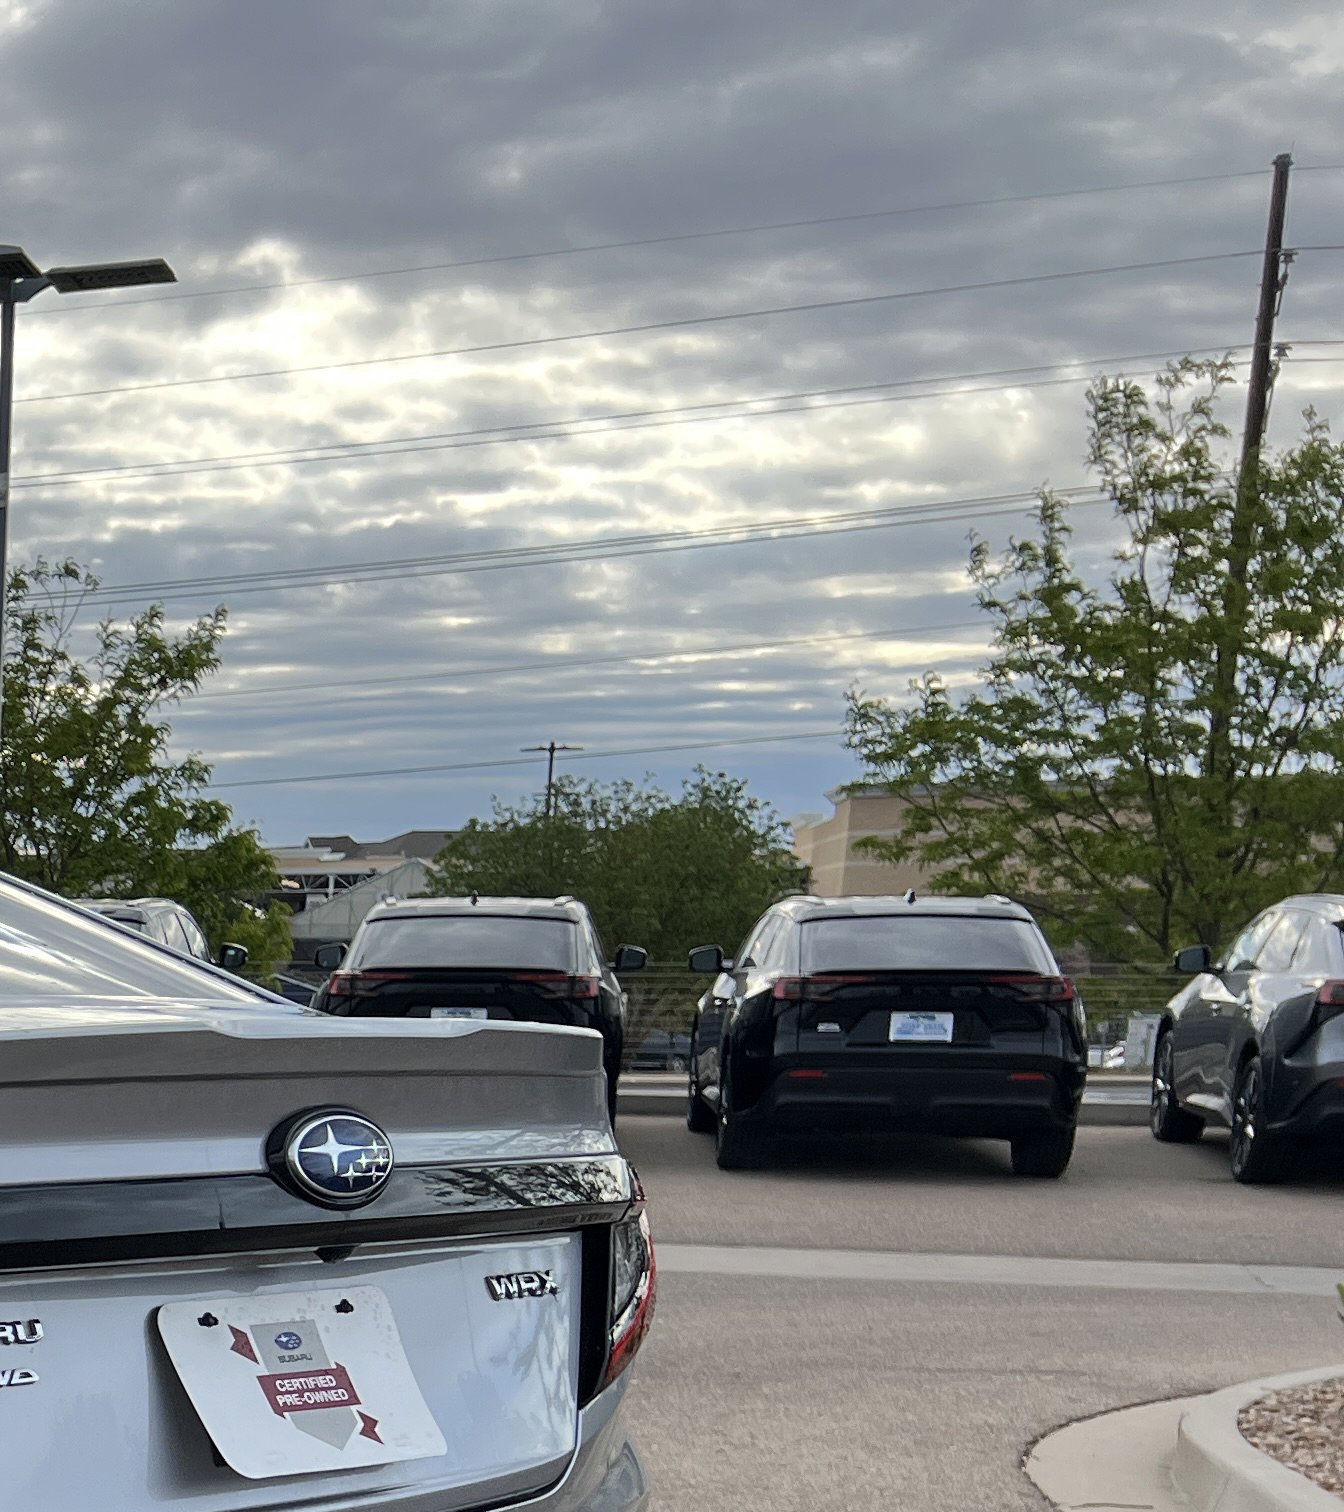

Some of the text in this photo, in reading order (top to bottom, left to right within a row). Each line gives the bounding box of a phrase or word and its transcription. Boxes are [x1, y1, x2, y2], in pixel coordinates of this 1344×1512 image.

[484, 1270, 559, 1301] WRX
[275, 1375, 337, 1392] CERTIFIED
[275, 1388, 349, 1407] PRE-OWNED
